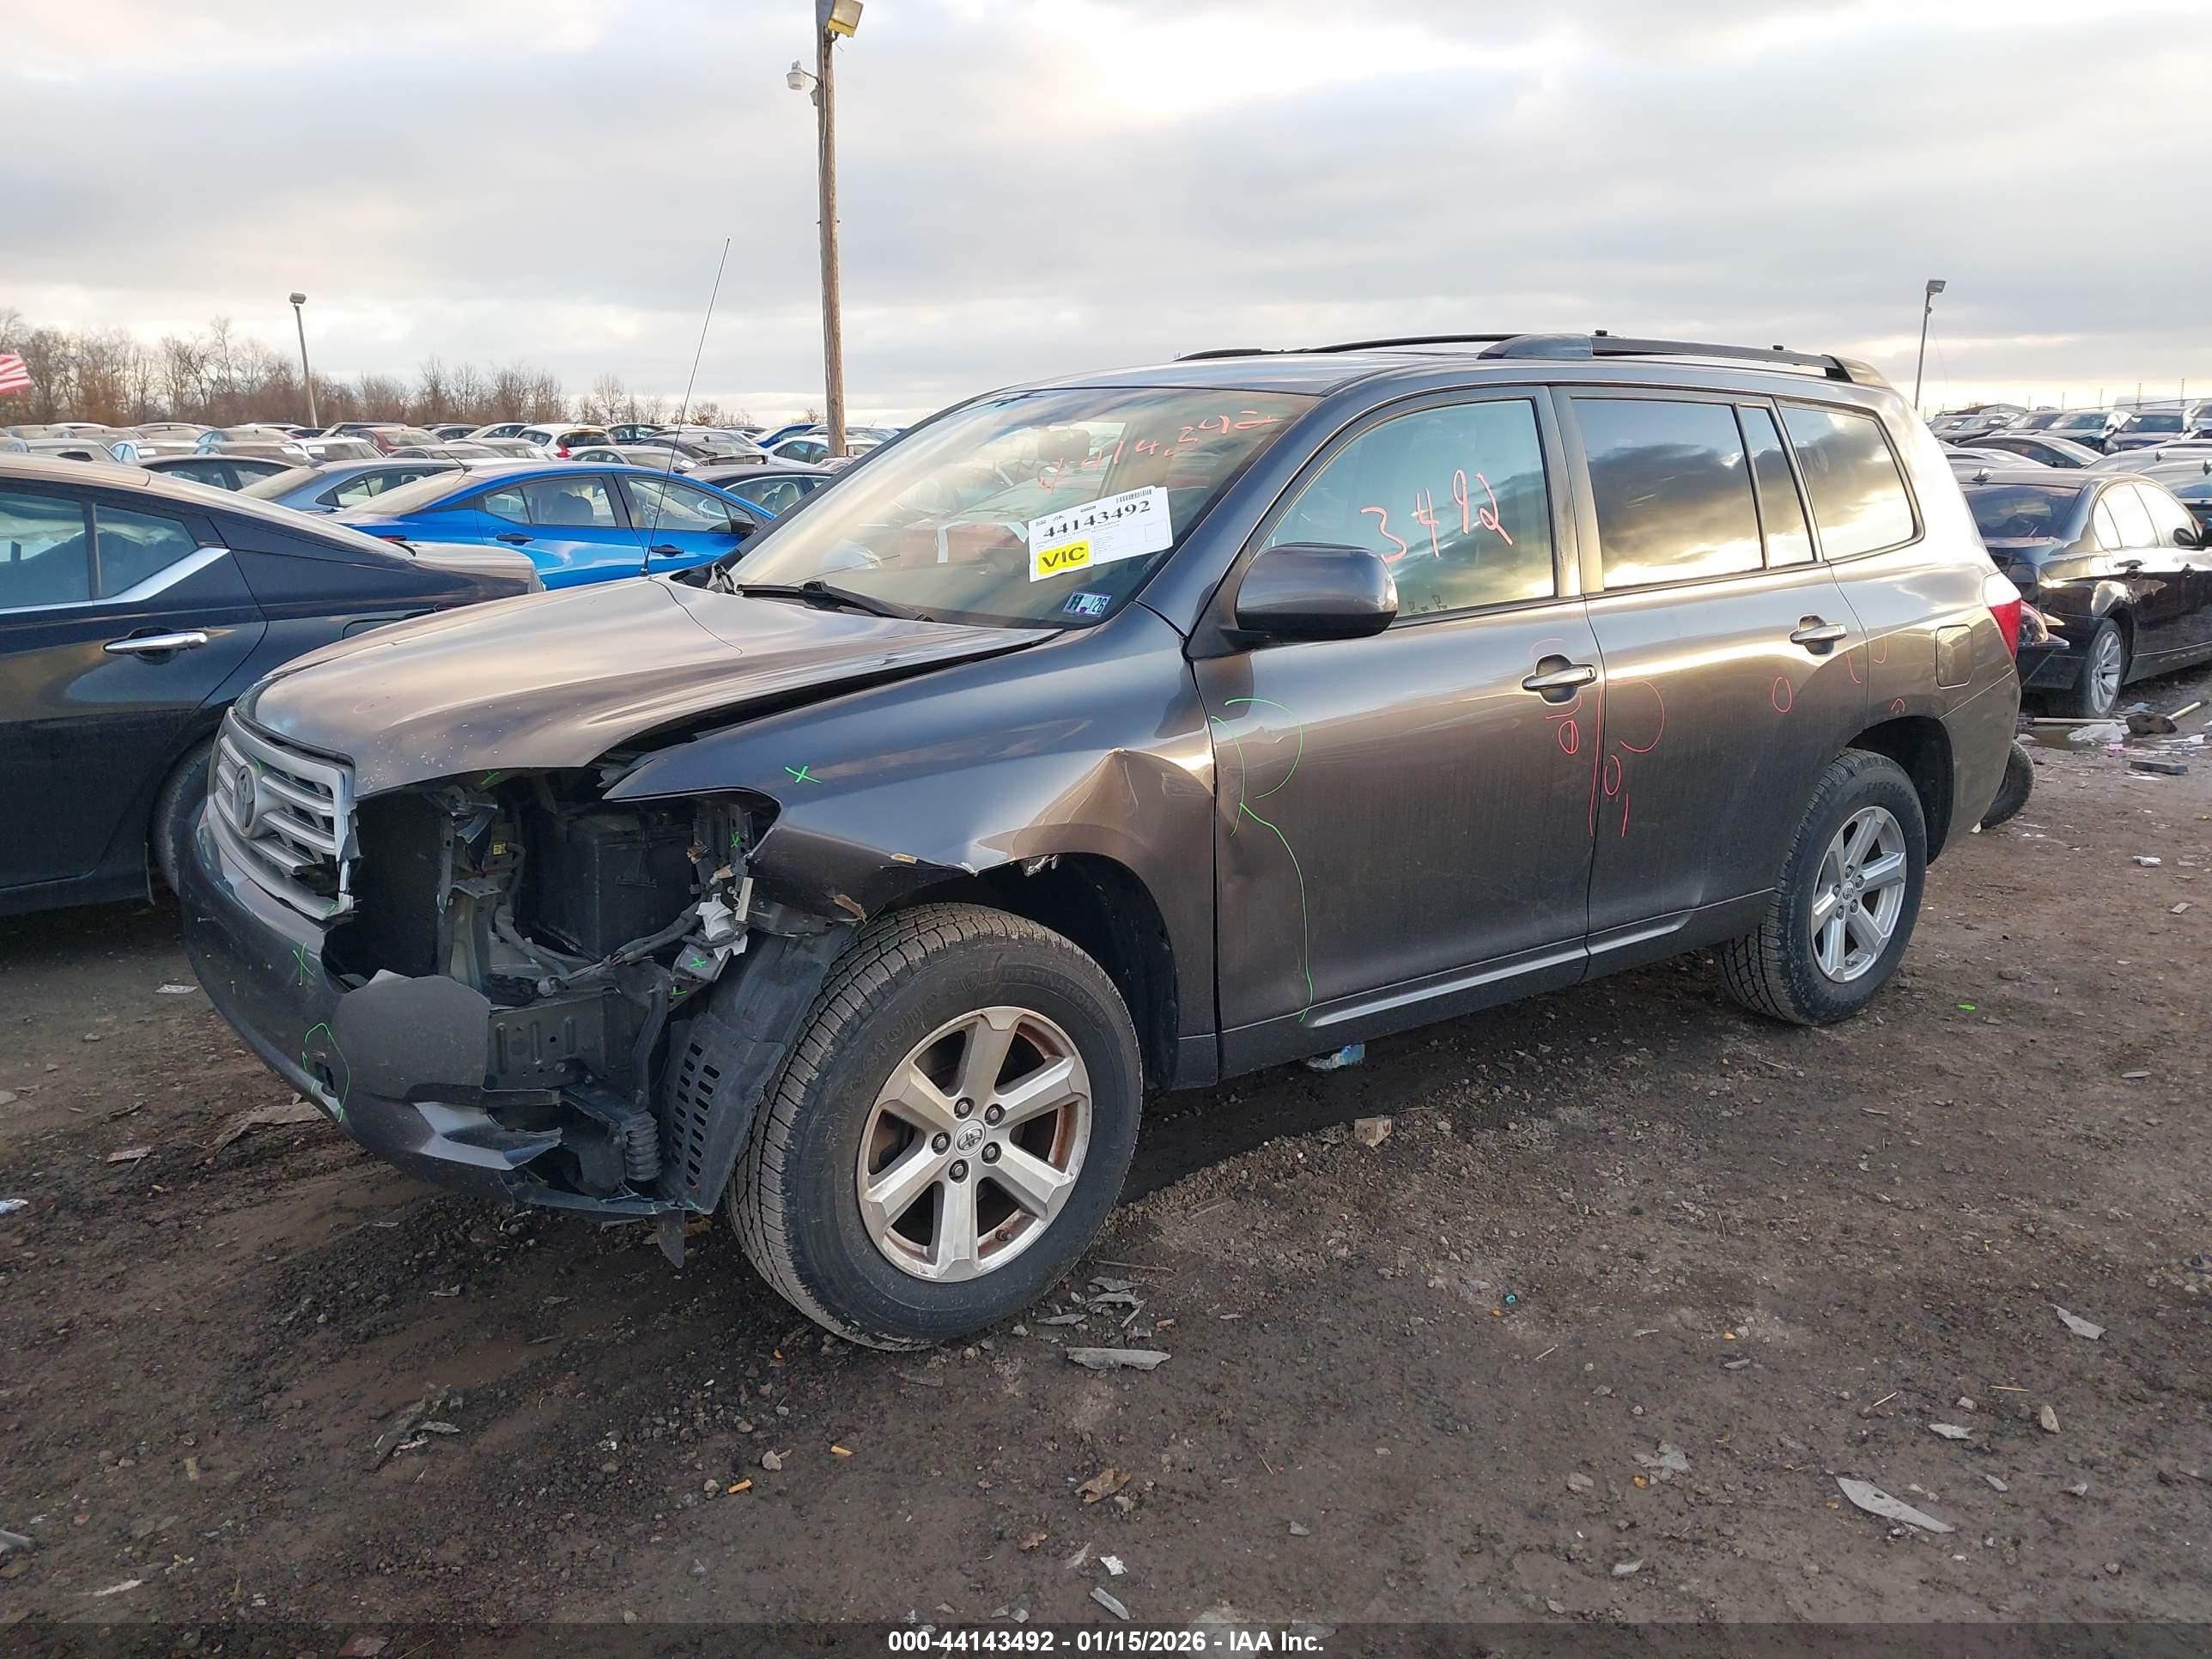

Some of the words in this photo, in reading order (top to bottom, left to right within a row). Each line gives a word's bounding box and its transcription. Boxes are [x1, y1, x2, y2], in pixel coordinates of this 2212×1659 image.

[1042, 500, 1152, 538] 44143492
[1360, 469, 1514, 563] 3492
[1041, 546, 1086, 568] VIC
